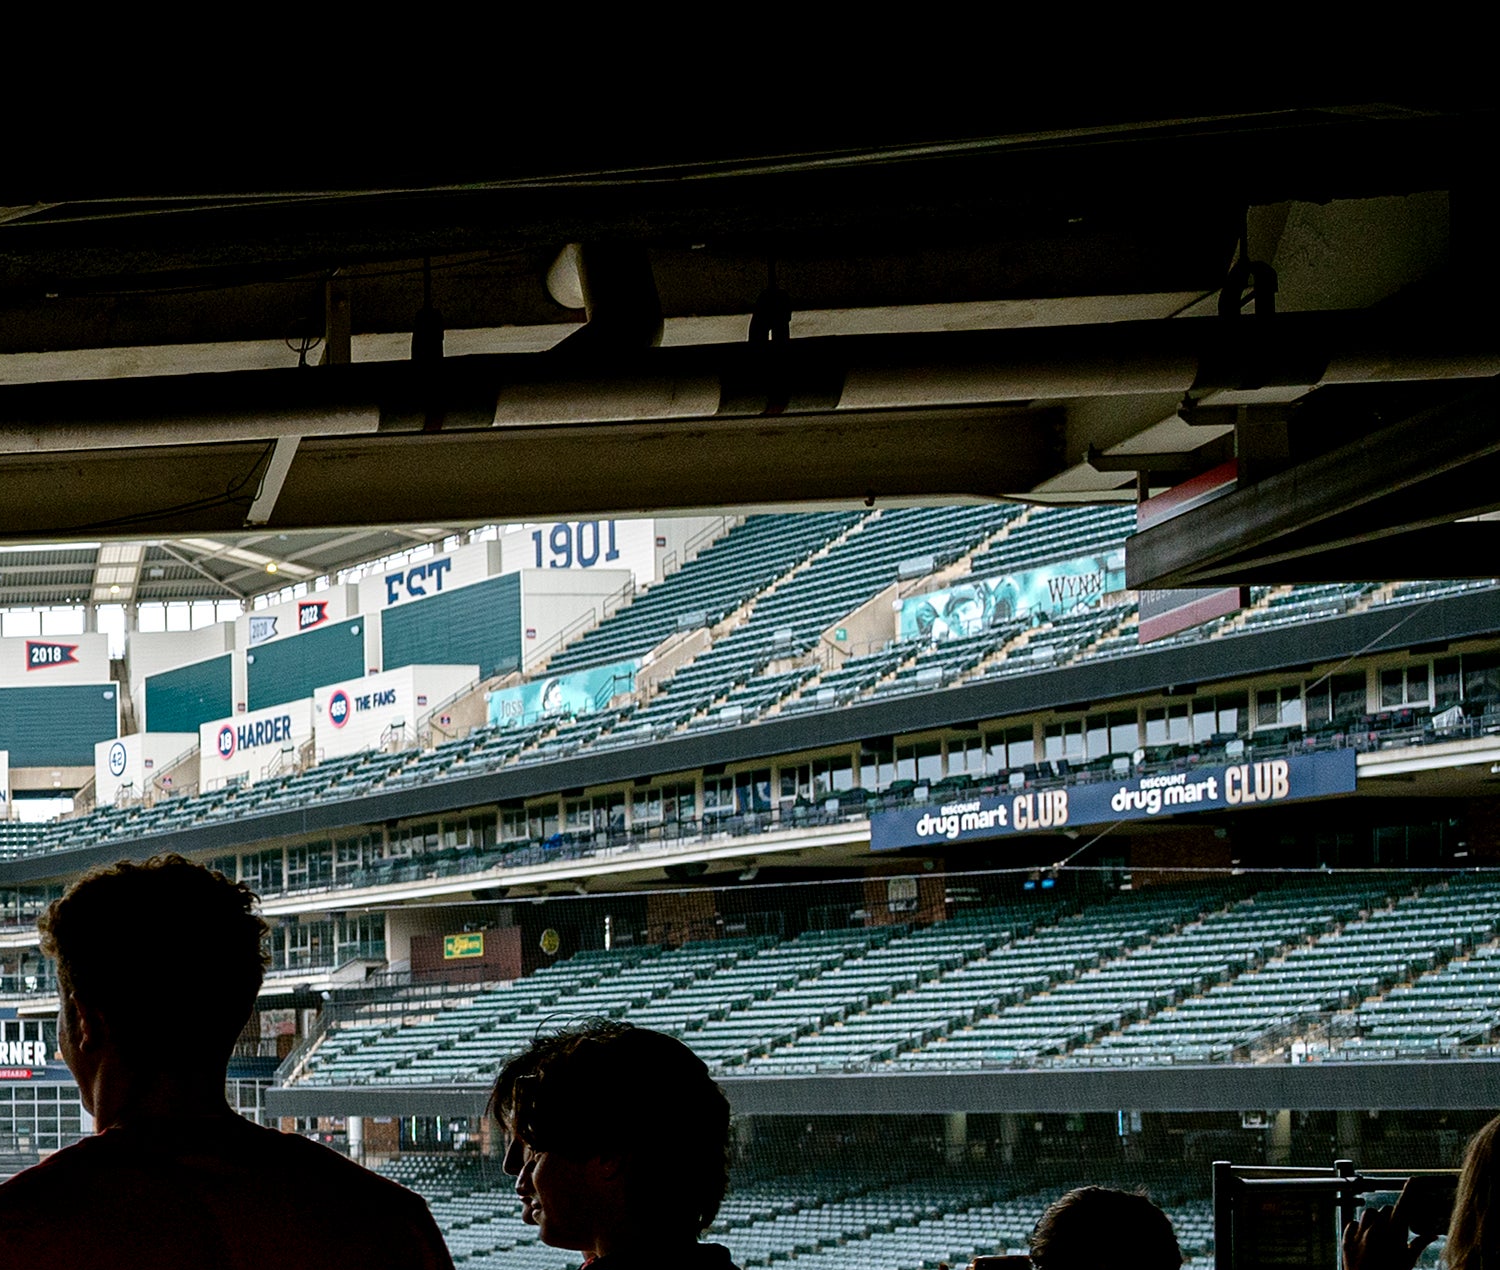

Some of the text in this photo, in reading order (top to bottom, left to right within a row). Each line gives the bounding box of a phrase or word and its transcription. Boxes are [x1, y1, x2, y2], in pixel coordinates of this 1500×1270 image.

[532, 520, 620, 568] 1901
[300, 604, 318, 625] 2022
[31, 647, 62, 663] 2018
[330, 688, 396, 717] 455 THE FANS
[219, 715, 291, 752] 18 HARDER
[111, 751, 123, 767] 42
[1111, 760, 1289, 814] drug mart CLUB
[1140, 773, 1186, 789] DISCOUNT
[916, 789, 1068, 839] drug mart CLUB
[941, 801, 981, 816] DISCOUNT
